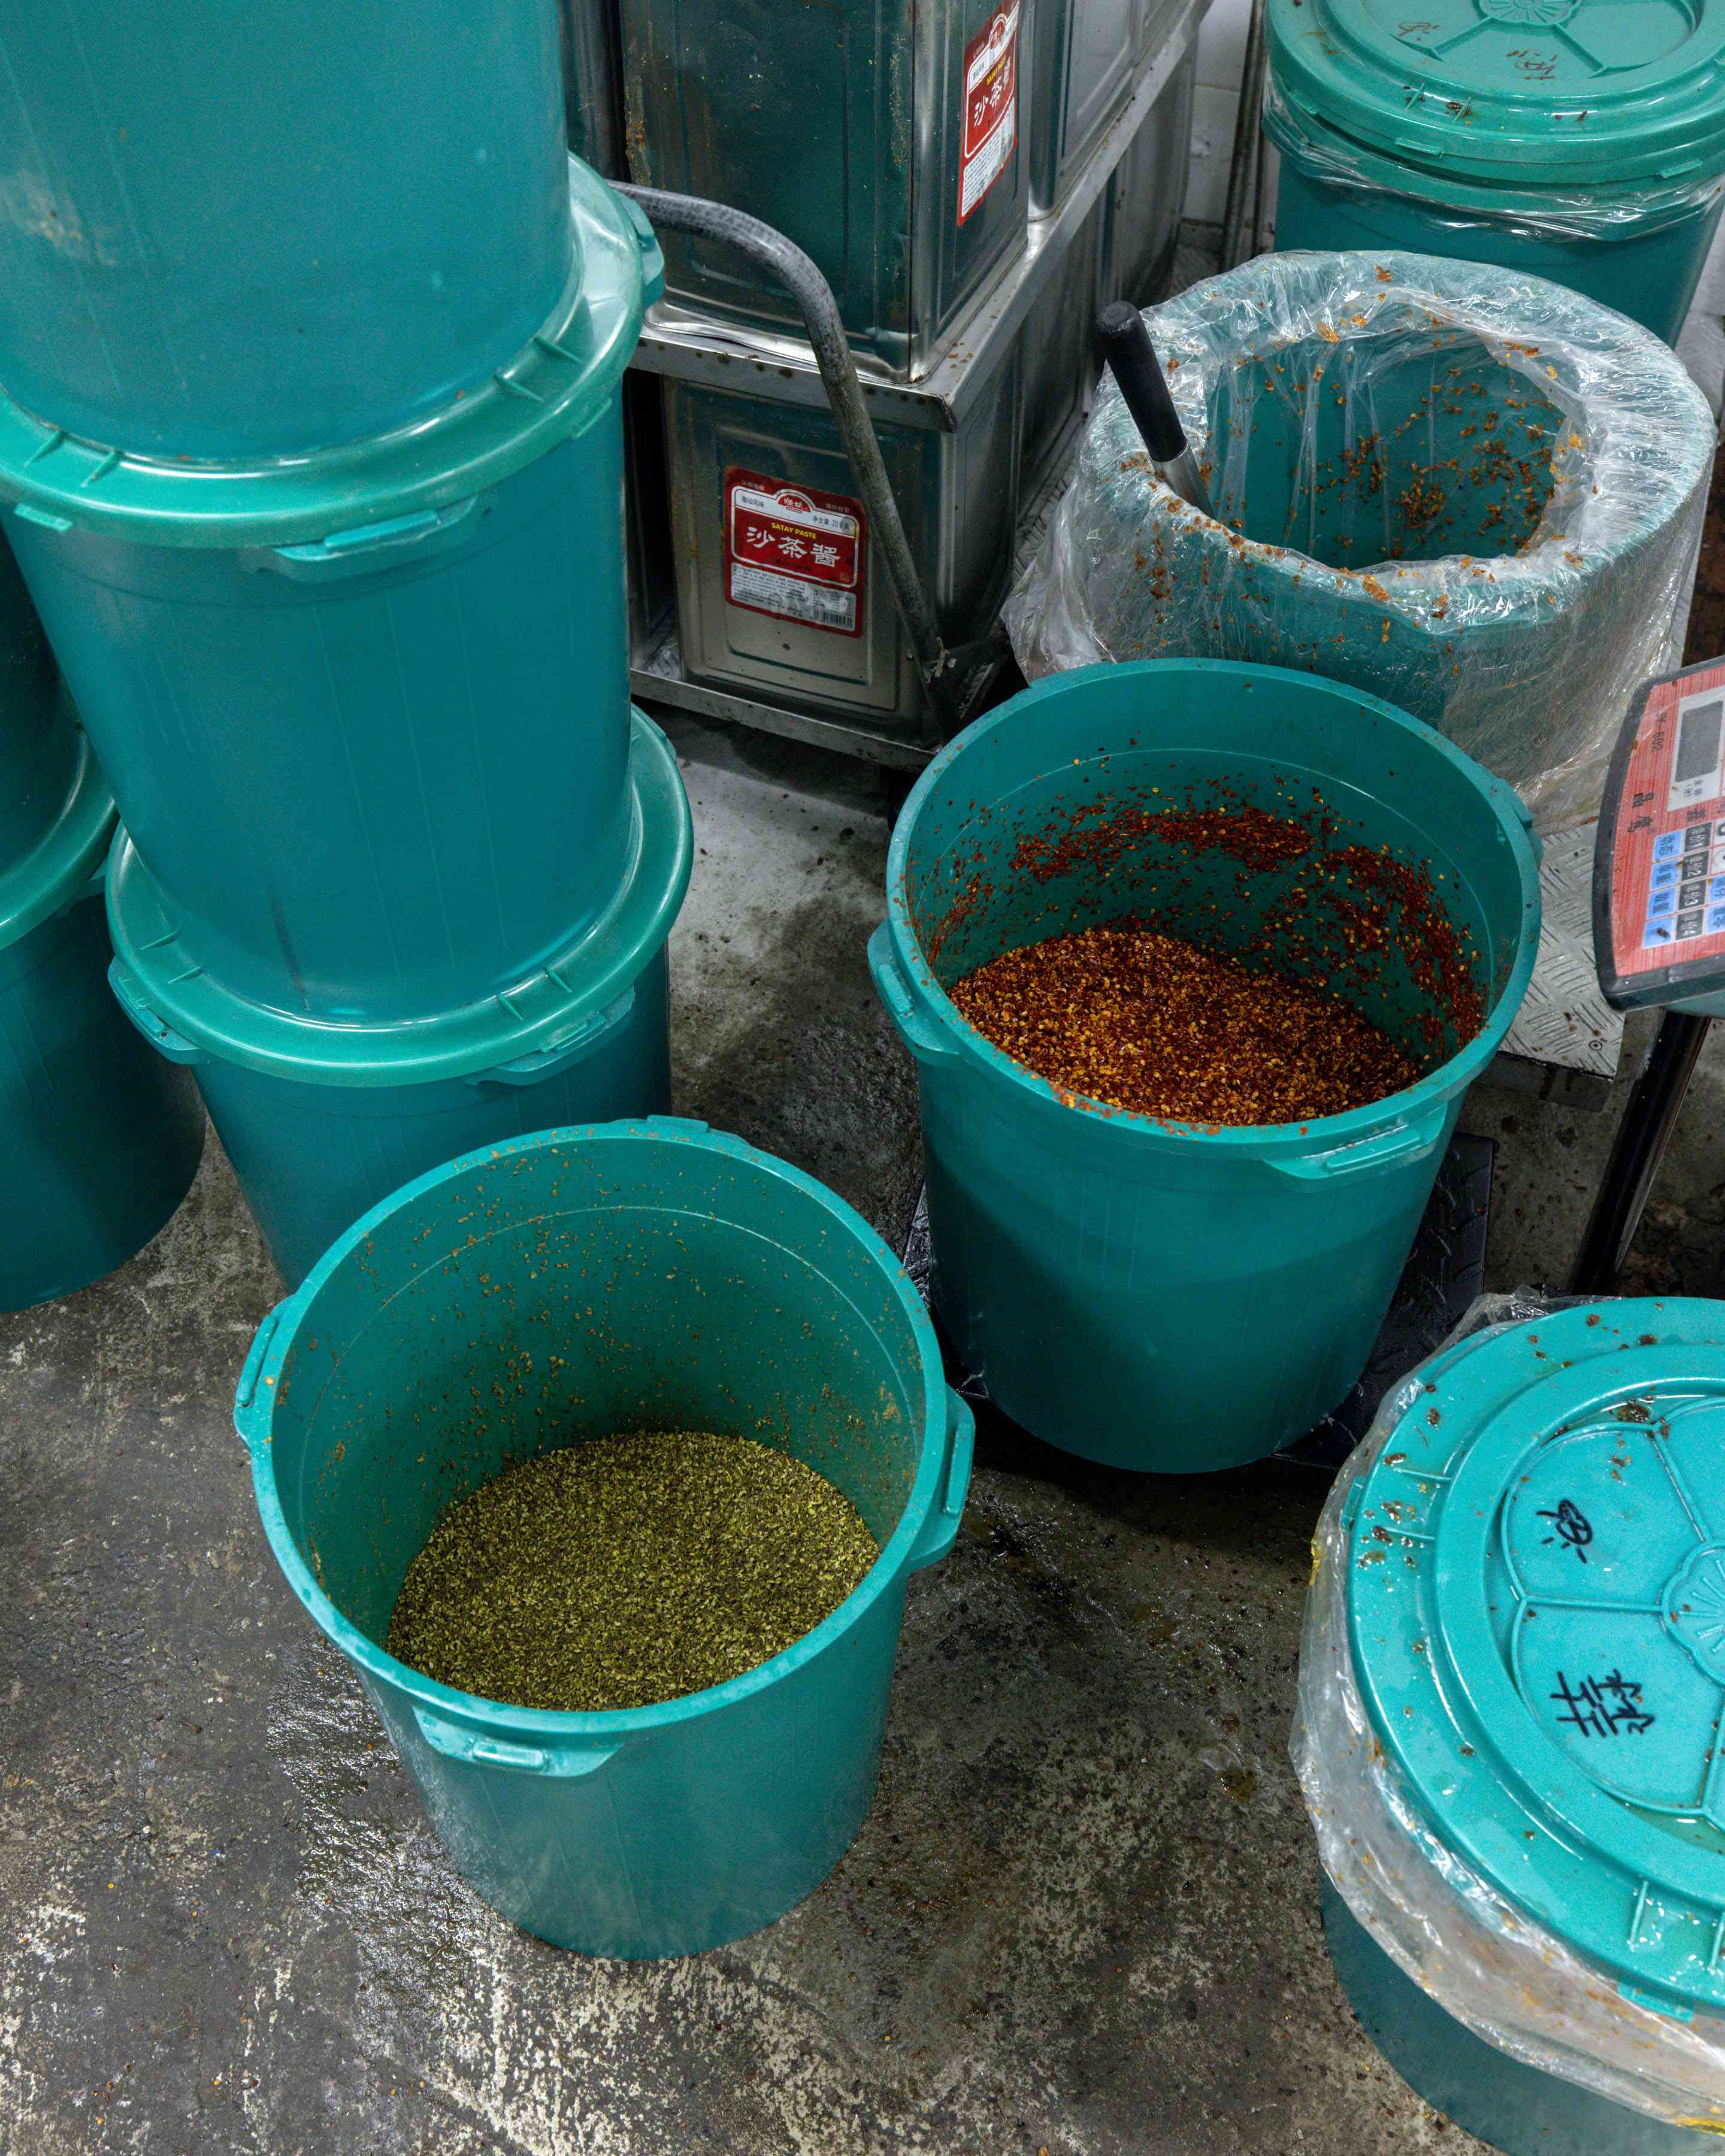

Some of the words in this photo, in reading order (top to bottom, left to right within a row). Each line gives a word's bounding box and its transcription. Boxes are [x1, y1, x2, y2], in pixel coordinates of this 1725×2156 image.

[771, 522, 794, 534] SATAY
[795, 528, 818, 540] PASTE
[747, 526, 841, 568] 沙茶酱
